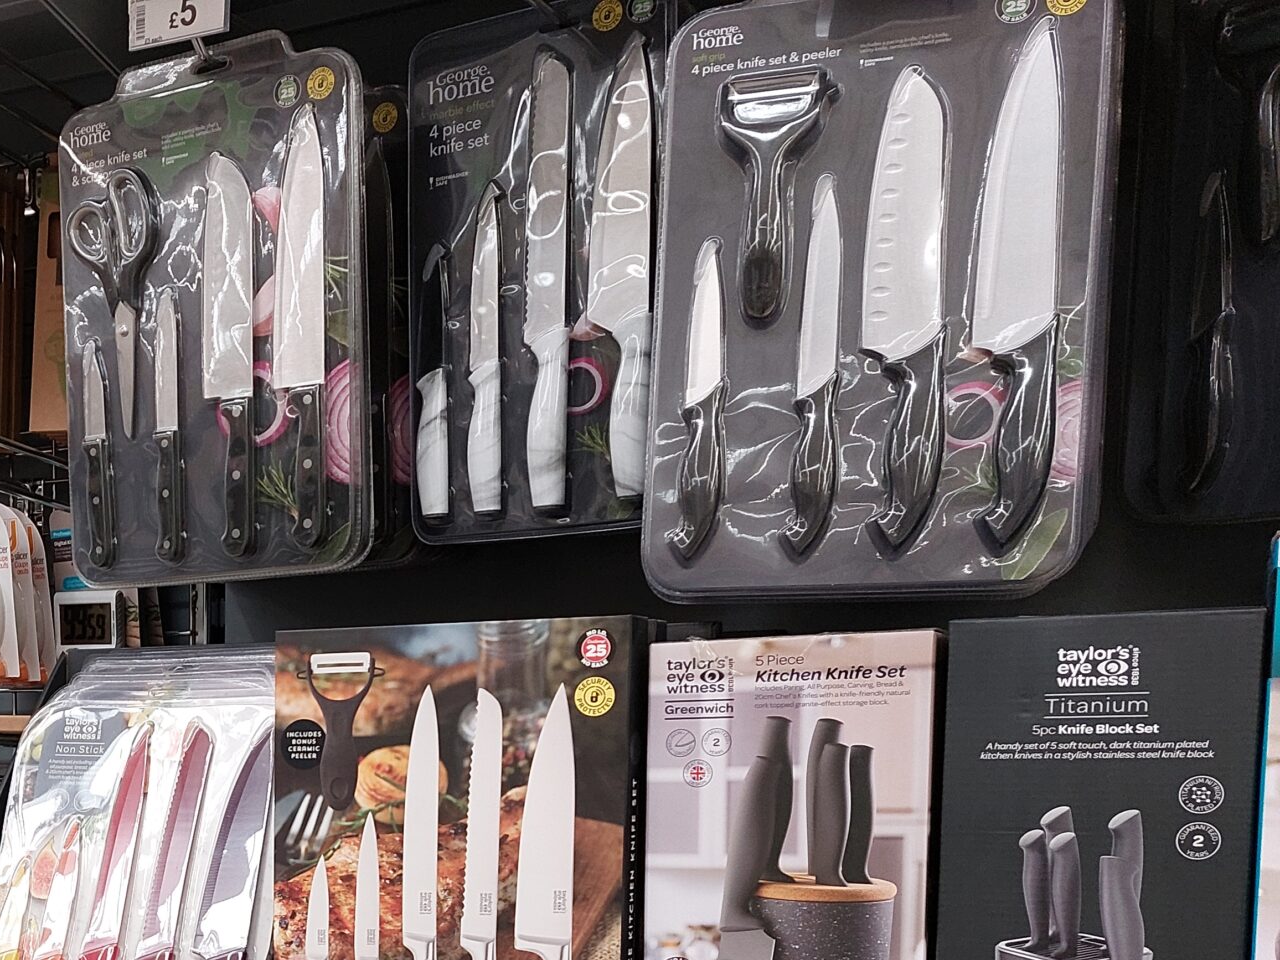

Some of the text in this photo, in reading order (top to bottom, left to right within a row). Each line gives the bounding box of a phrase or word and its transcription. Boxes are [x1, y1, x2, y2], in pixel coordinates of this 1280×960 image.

[692, 32, 744, 50] home
[692, 47, 842, 77] 4 piece knife set & peeler
[756, 655, 804, 666] 5 Piece
[1058, 646, 1130, 662] taylor's
[755, 665, 906, 682] Kitchen Knife Set
[1058, 662, 1092, 675] eye
[1058, 675, 1128, 687] witness
[665, 704, 734, 714] Greenwich
[1048, 698, 1148, 714] Titanium
[1032, 724, 1159, 736] 5pc Knife Block Set
